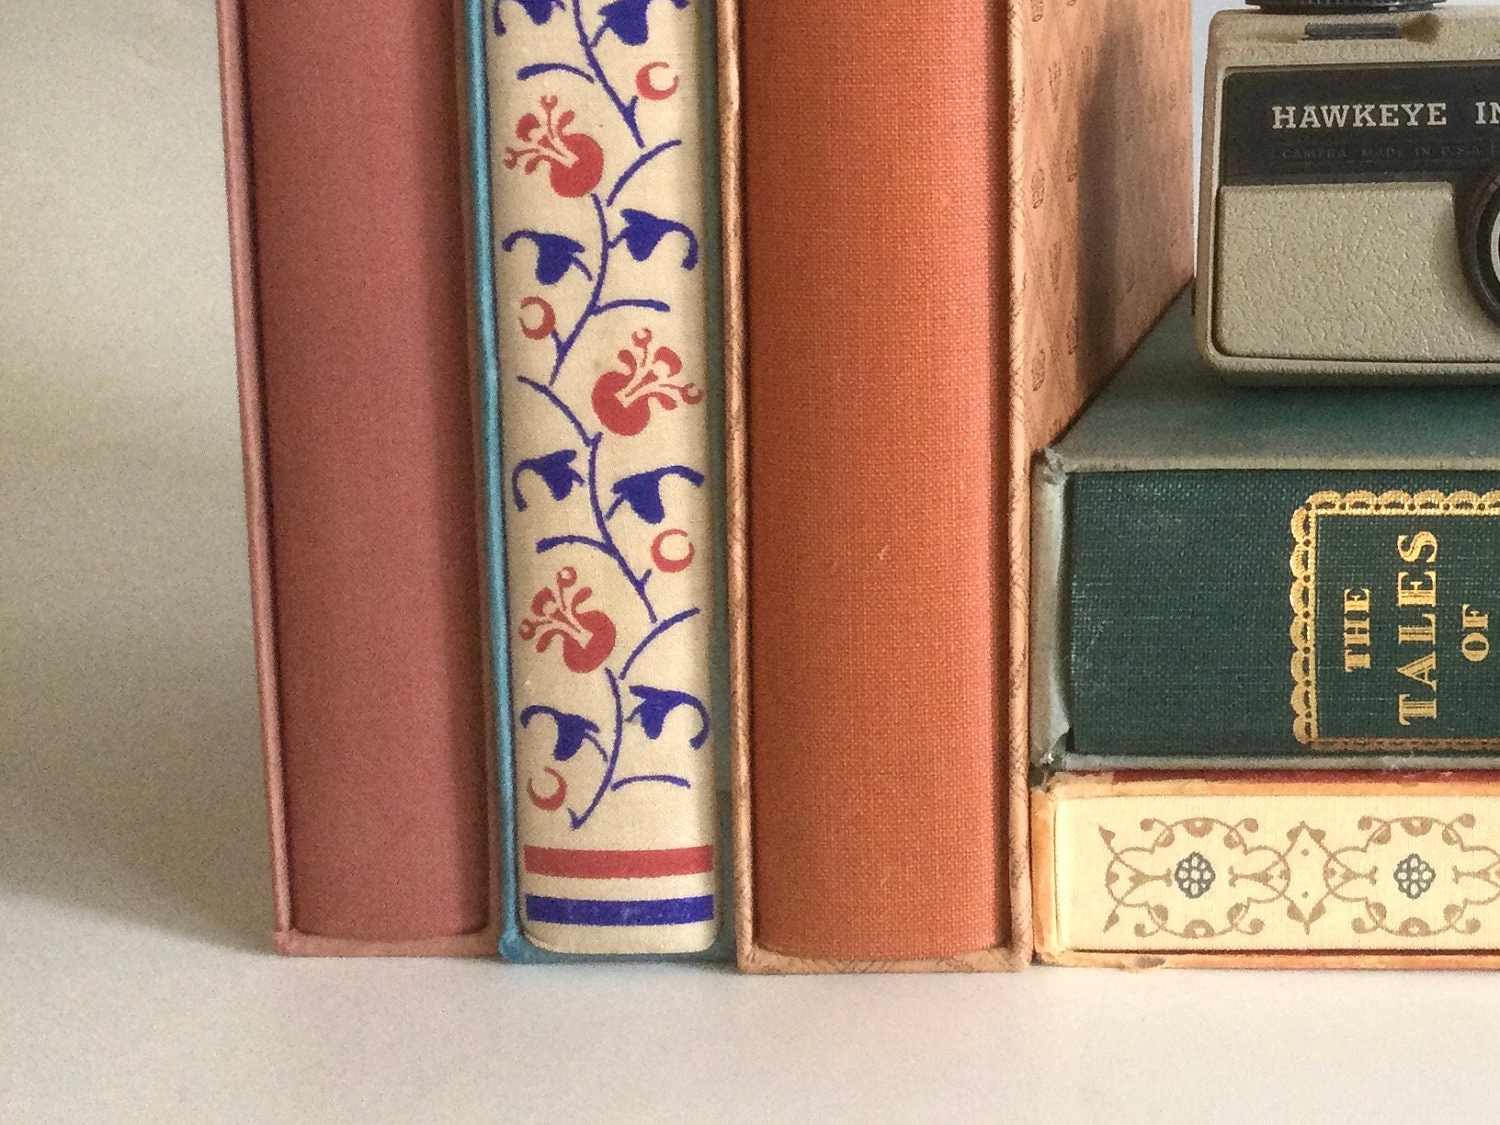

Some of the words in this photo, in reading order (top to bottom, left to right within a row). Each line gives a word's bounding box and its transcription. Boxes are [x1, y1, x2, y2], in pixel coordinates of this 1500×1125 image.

[1272, 102, 1447, 130] HAWKEYE
[1344, 588, 1371, 672] THE
[1397, 531, 1438, 726] TALES
[1461, 604, 1489, 662] OF
